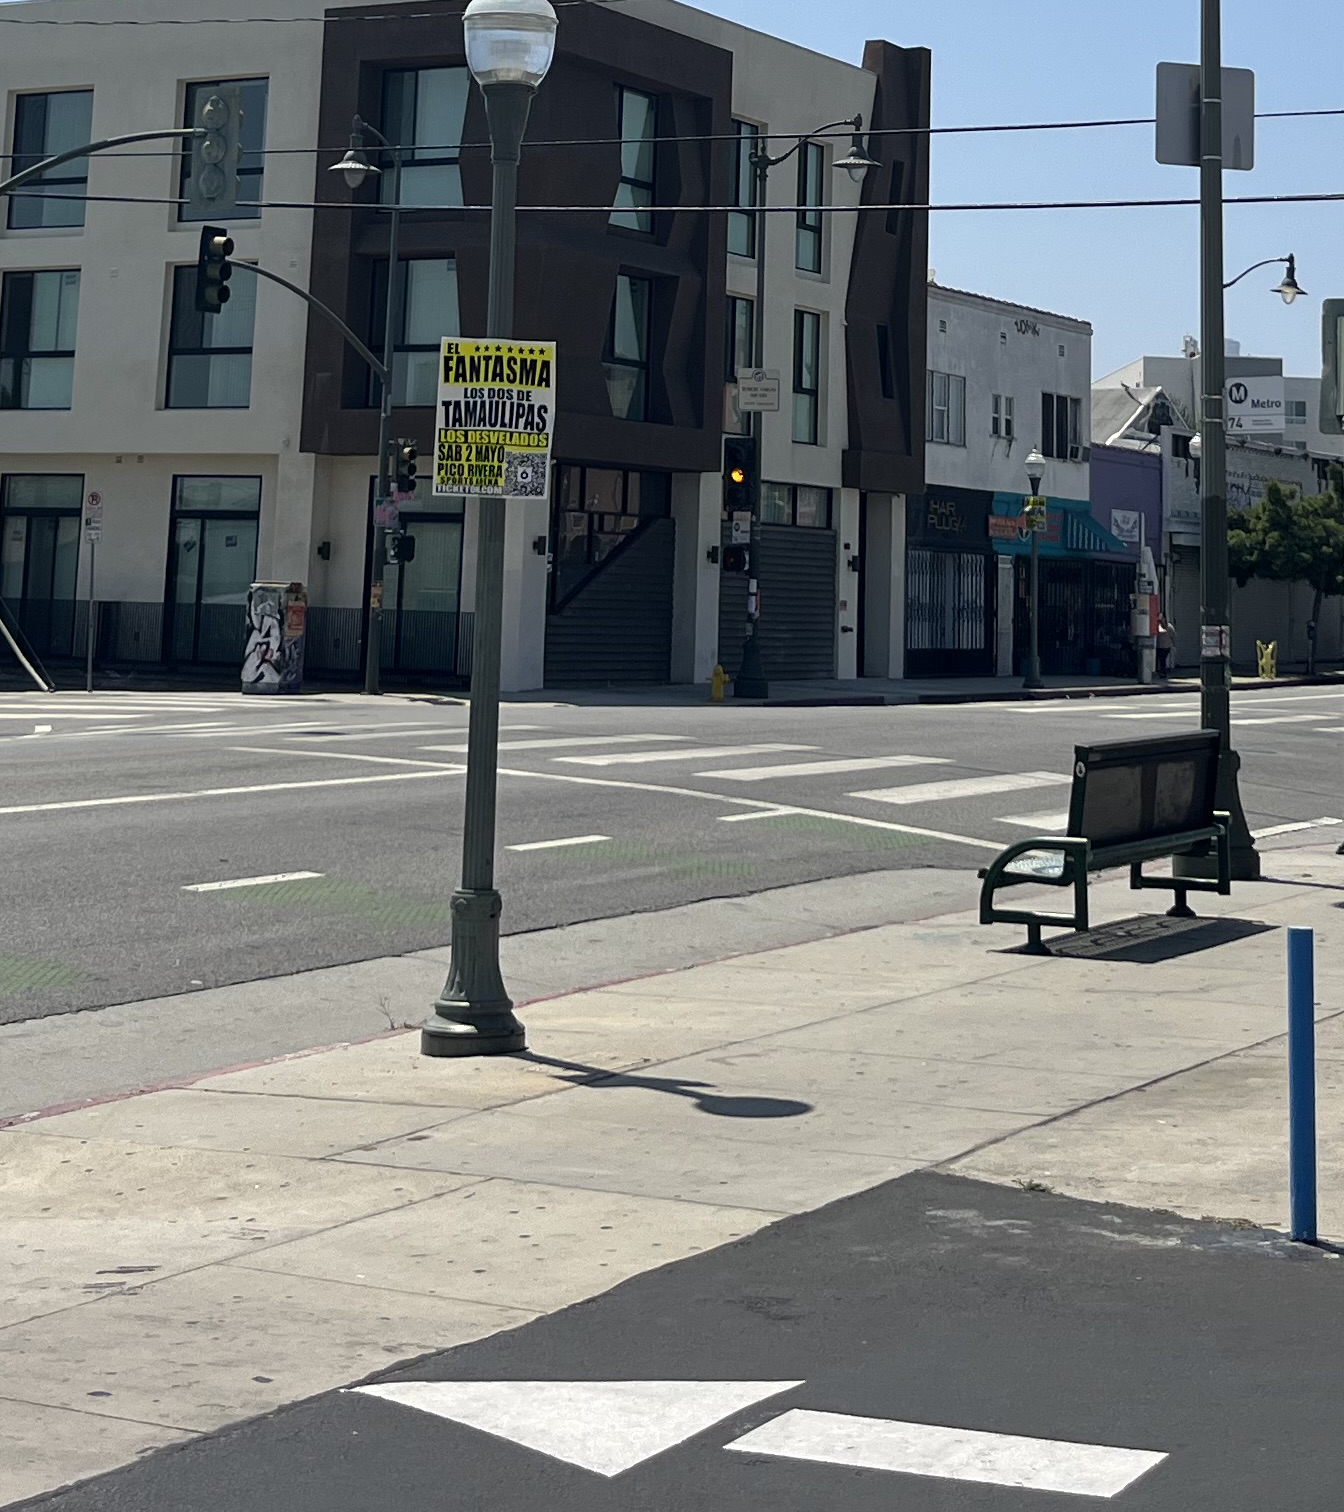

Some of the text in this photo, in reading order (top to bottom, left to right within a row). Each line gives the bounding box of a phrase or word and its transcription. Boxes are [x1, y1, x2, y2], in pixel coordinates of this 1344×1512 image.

[447, 343, 461, 355] EL
[443, 354, 551, 388] FANTASMA
[463, 387, 533, 402] LOS DOS DE
[1250, 398, 1282, 409] Metro
[441, 399, 549, 433] TAMAULIPAS
[1228, 417, 1244, 429] 74
[440, 429, 548, 447] LOS DESVELADOS
[437, 443, 505, 464] SAB 2 MAYO
[437, 462, 503, 479] PICO RIVERA
